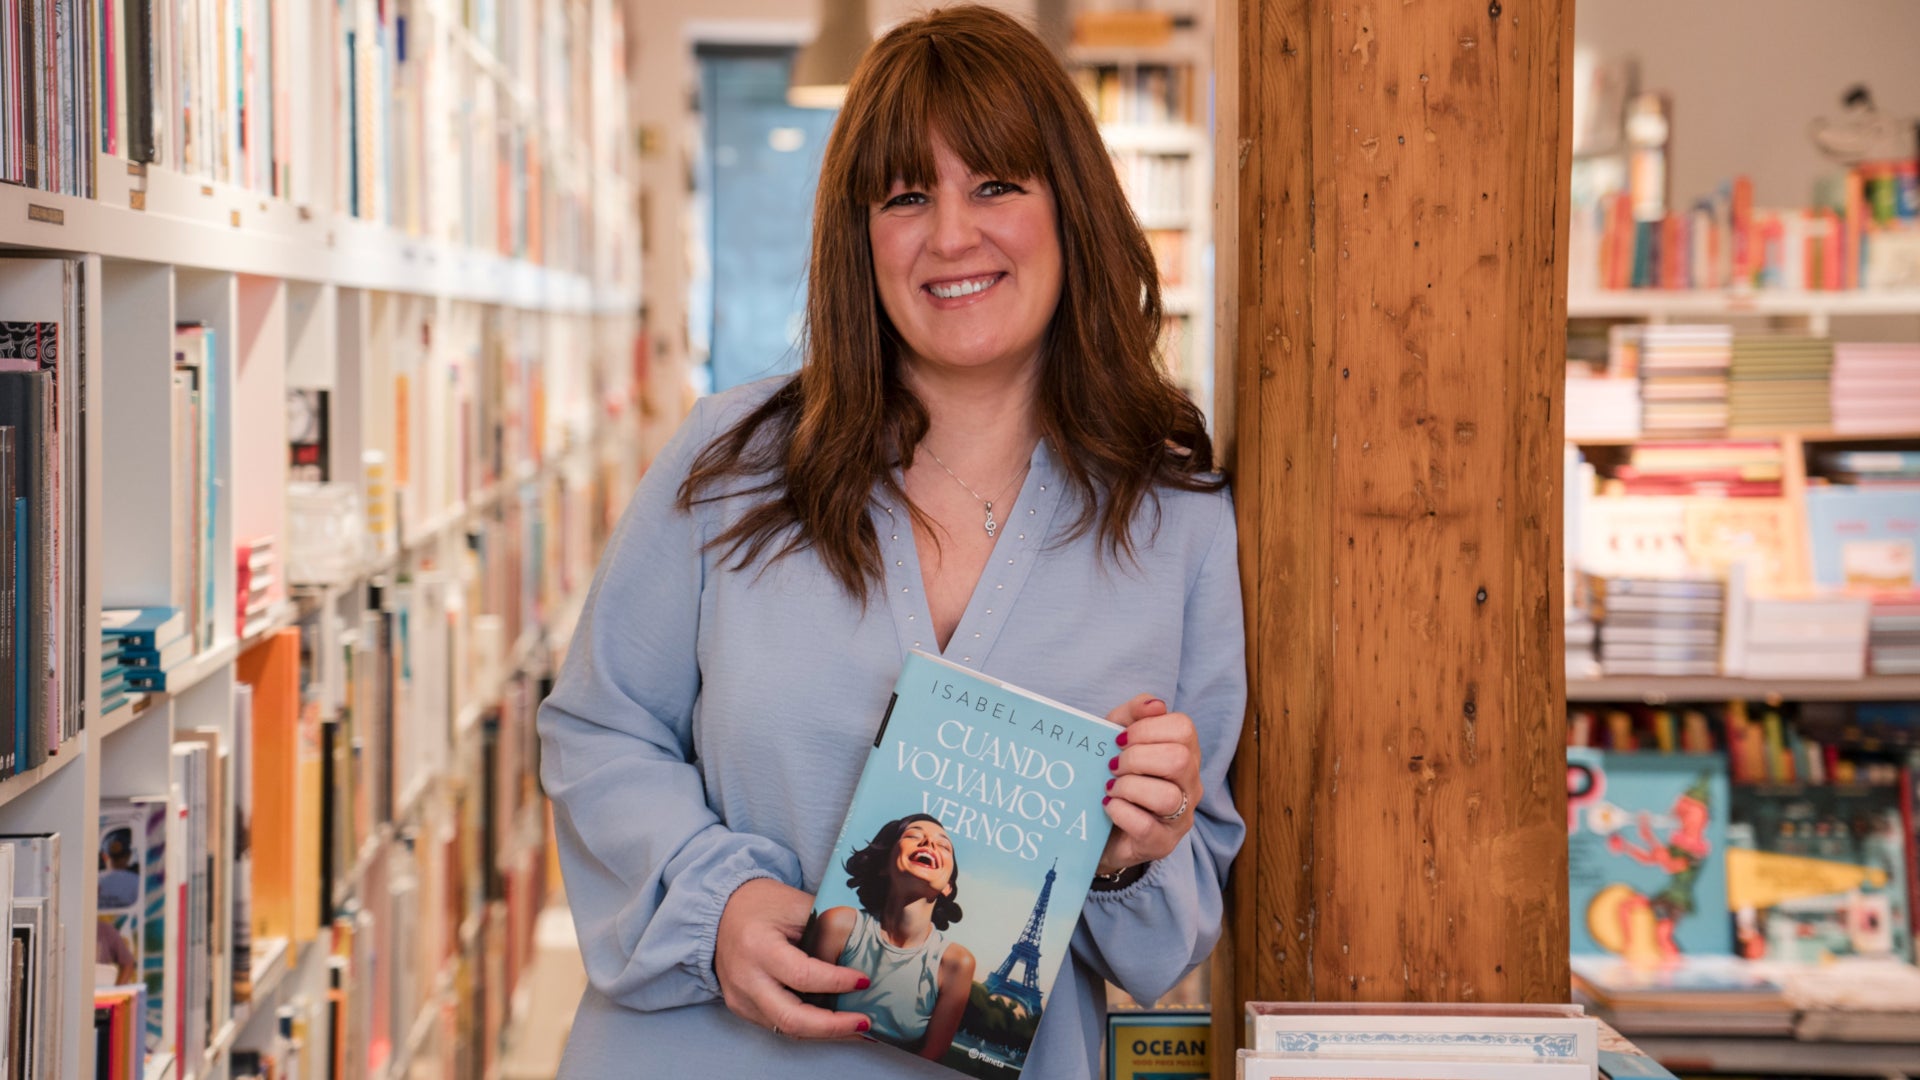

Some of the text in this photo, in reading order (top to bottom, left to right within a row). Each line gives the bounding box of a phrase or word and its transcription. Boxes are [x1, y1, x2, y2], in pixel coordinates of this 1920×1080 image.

[932, 680, 1108, 757] ISABEL ARIAS
[897, 740, 1087, 840] VOLVAMOS A
[937, 720, 1075, 790] CUANDO
[922, 791, 1043, 861] VERNOS
[979, 1052, 1005, 1068] Planeta
[1132, 1040, 1206, 1055] OCEAN
